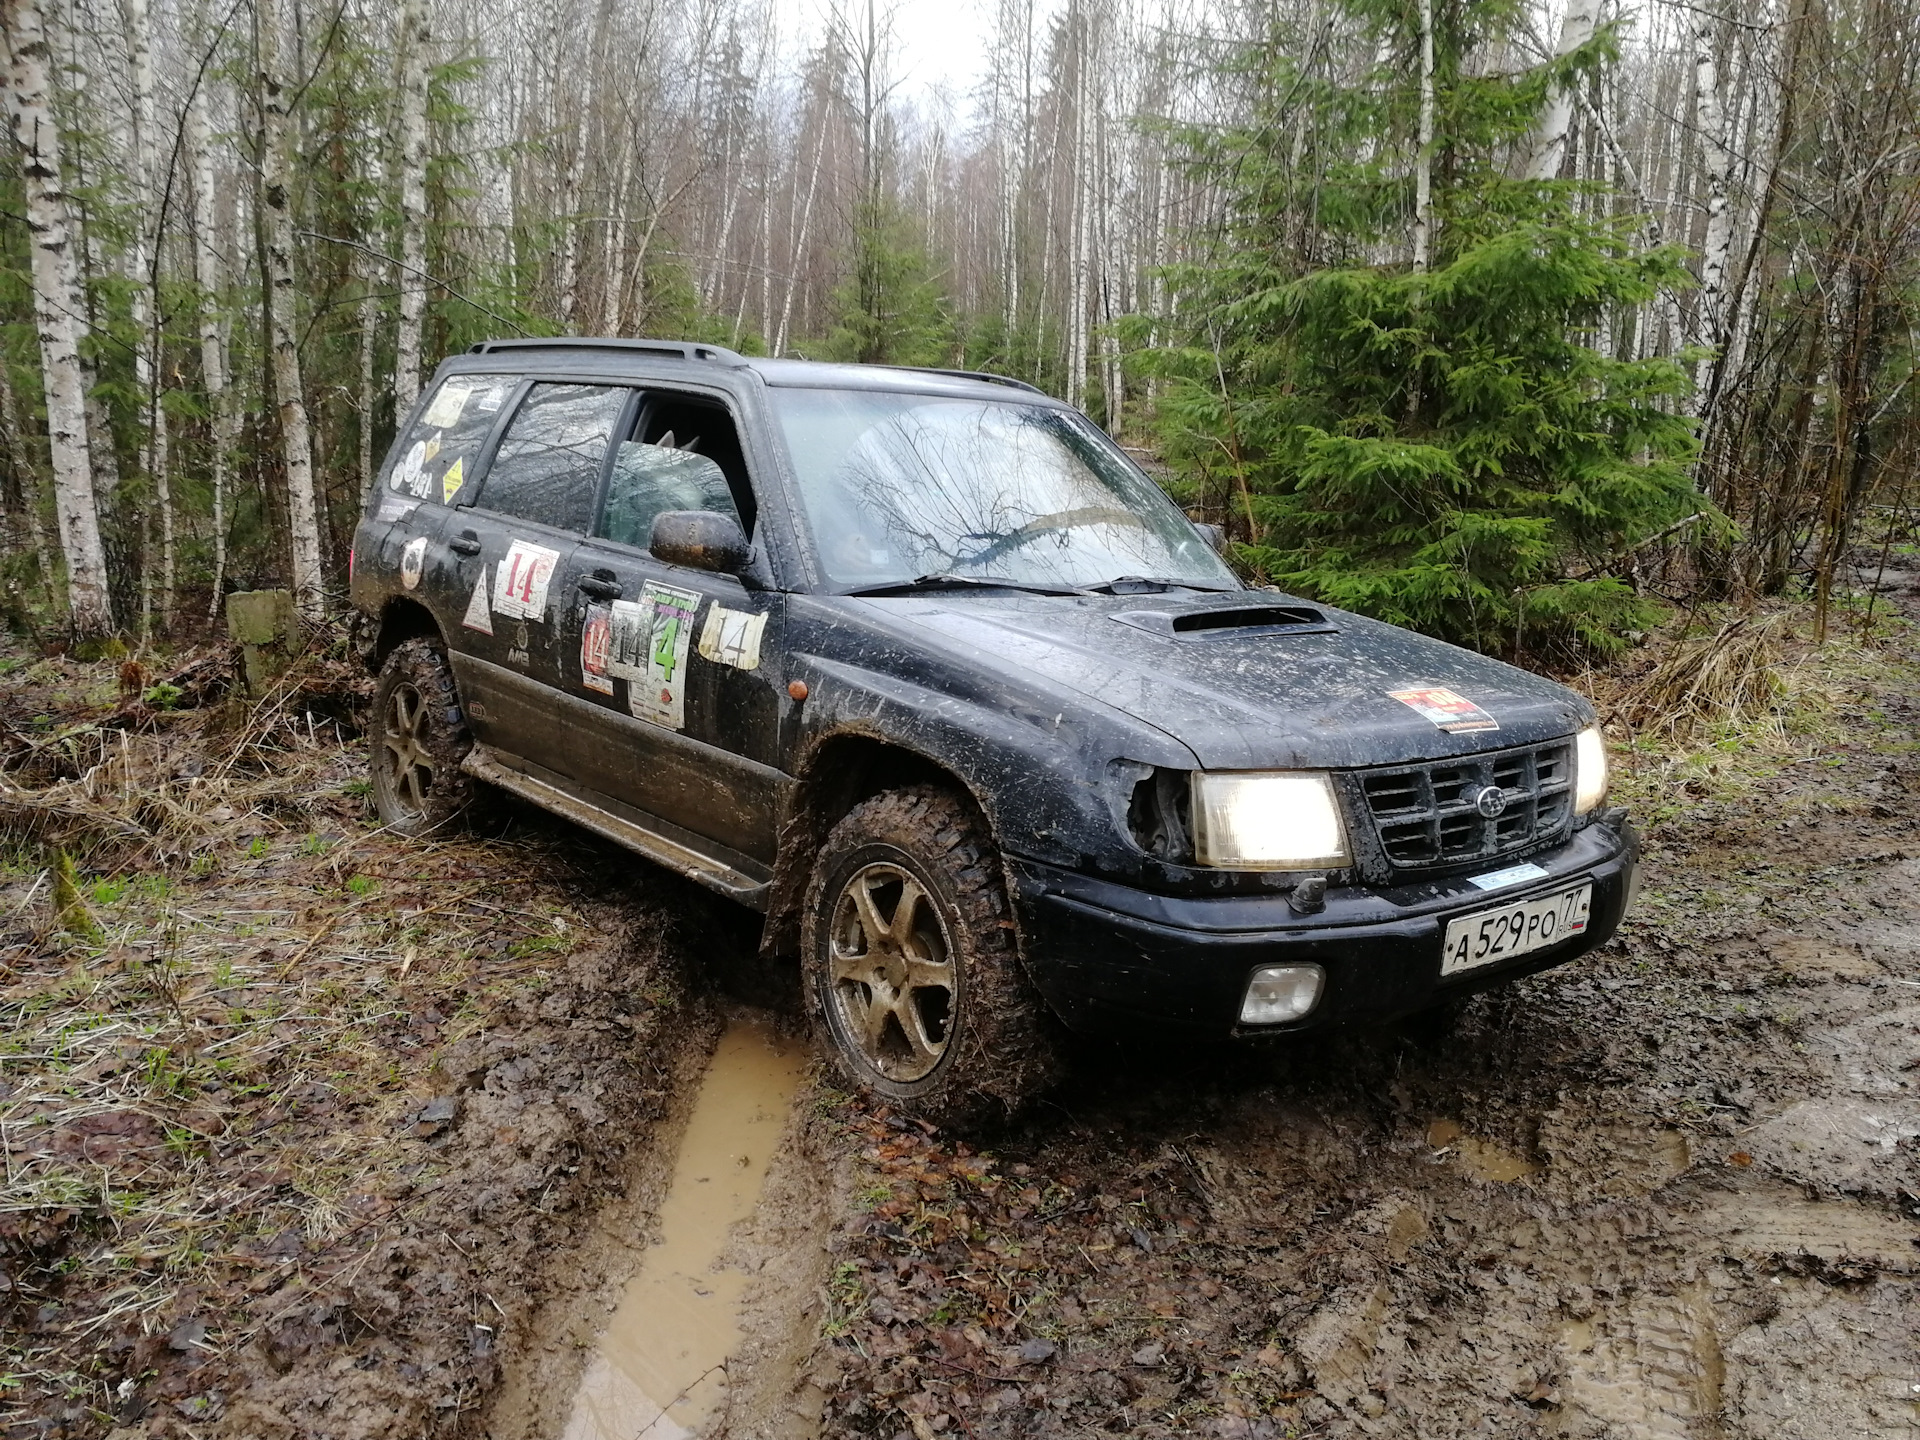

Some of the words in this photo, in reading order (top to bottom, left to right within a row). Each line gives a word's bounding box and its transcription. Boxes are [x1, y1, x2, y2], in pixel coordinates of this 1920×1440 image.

[506, 553, 532, 603] 14
[587, 625, 608, 669] 14
[616, 626, 642, 668] 14
[711, 616, 748, 671] 14
[1558, 921, 1573, 936] RUS
